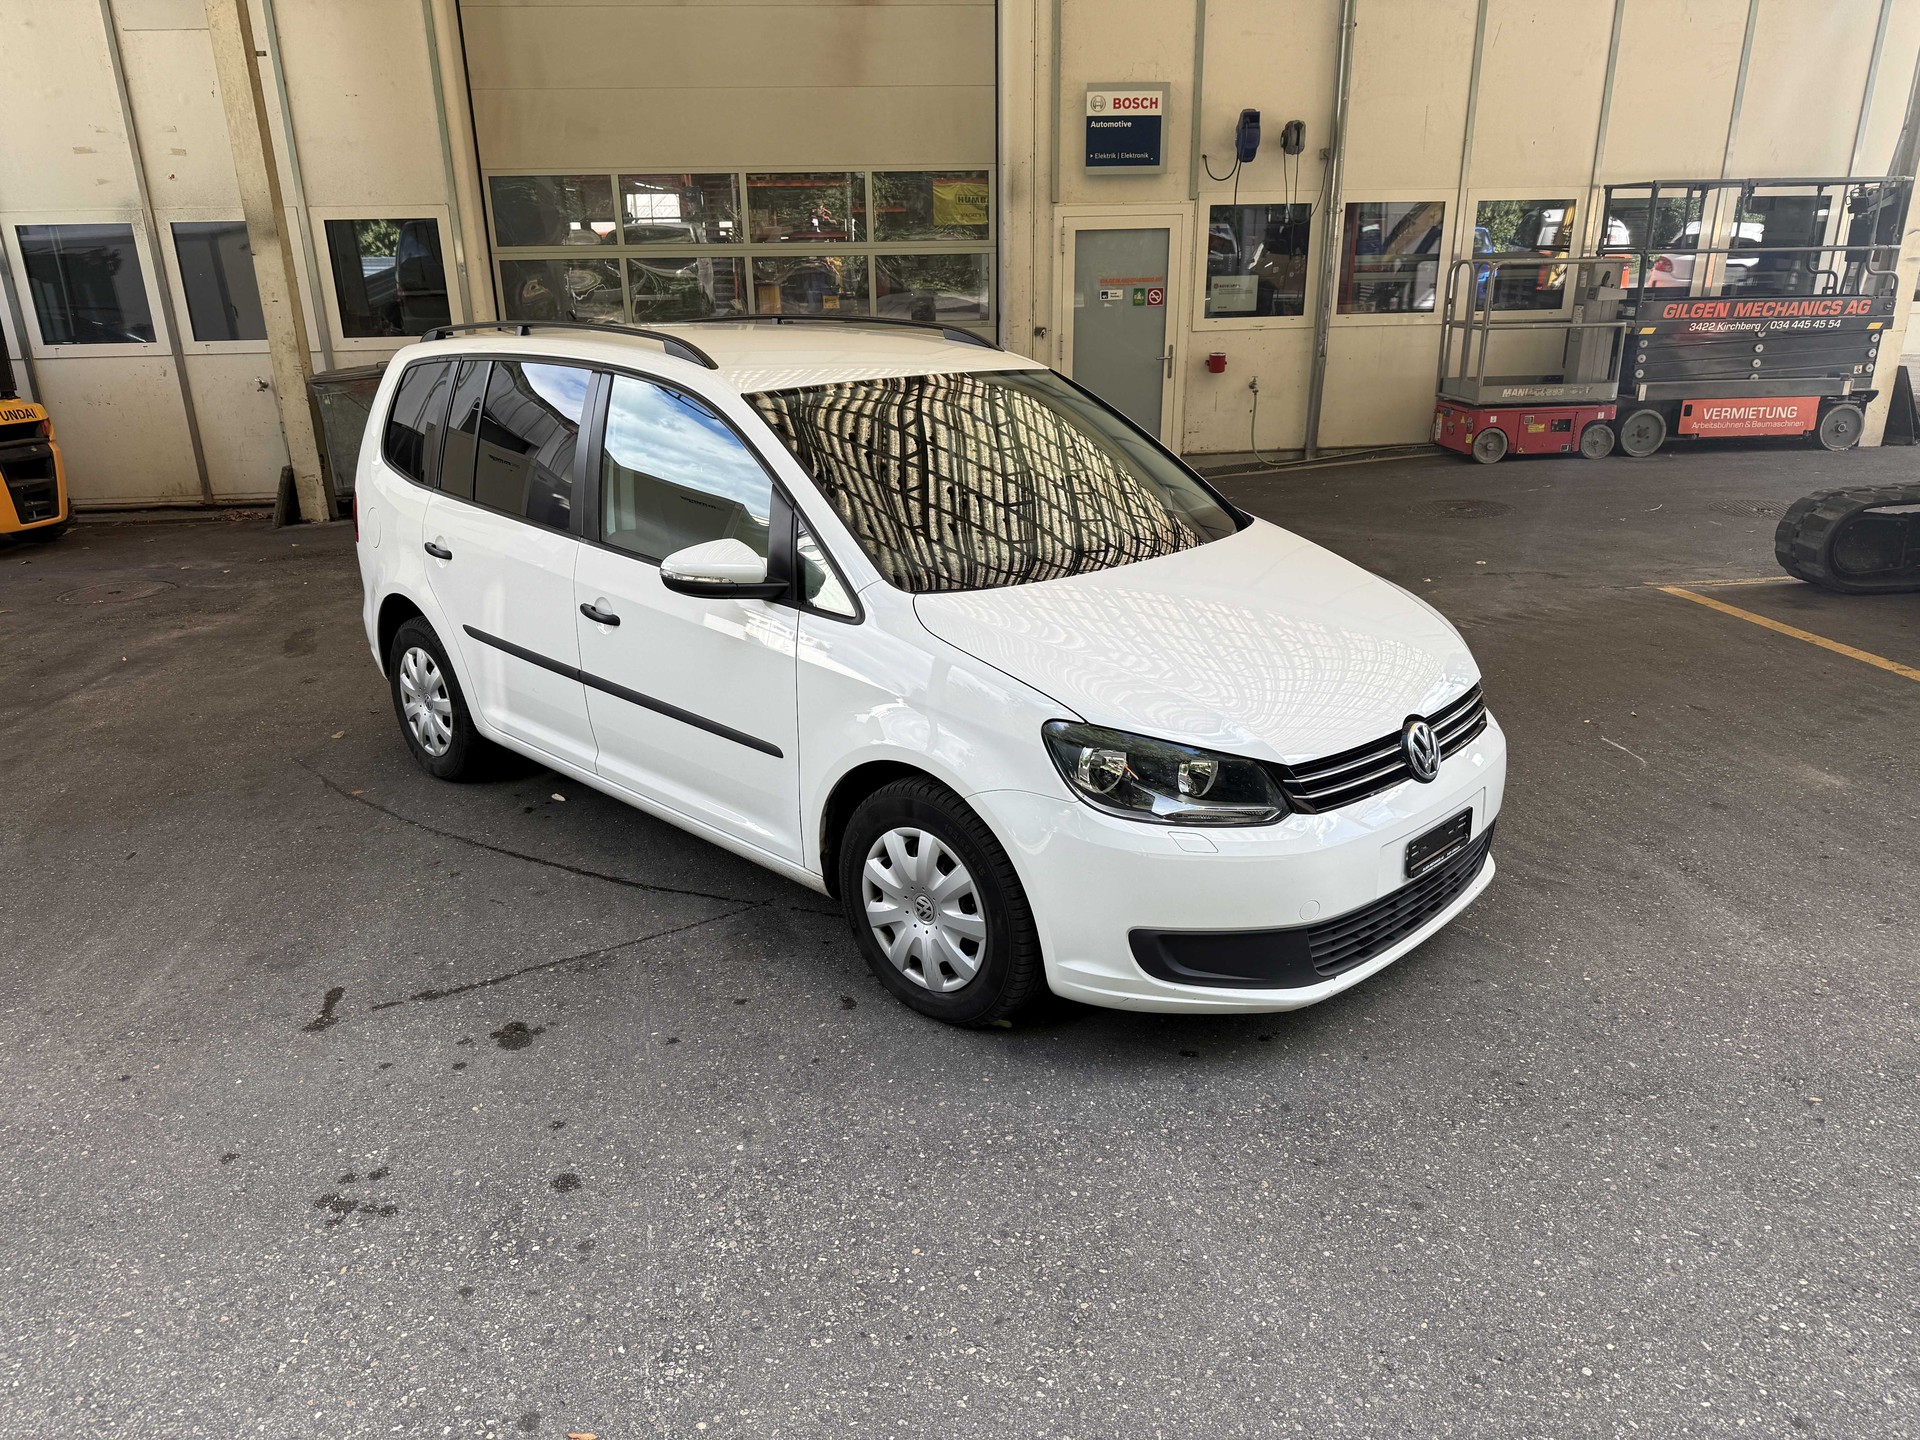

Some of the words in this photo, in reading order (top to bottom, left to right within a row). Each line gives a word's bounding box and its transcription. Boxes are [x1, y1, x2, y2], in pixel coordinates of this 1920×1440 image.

[1113, 97, 1158, 110] BOSCH
[1090, 120, 1132, 128] Automotive
[1662, 302, 1730, 319] GILGEN
[1733, 300, 1842, 318] MECHANICS
[1843, 299, 1872, 315] AG
[1688, 322, 1715, 332] 3422
[1716, 321, 1761, 332] Kirchberg
[1770, 320, 1790, 330] 034
[1792, 320, 1811, 329] 445
[1812, 319, 1826, 329] 45
[1827, 319, 1841, 329] 54
[1703, 406, 1798, 420] VERMIETUNG
[1691, 420, 1744, 430] Arbeitsbühnen
[1751, 419, 1804, 428] Baumaschinen
